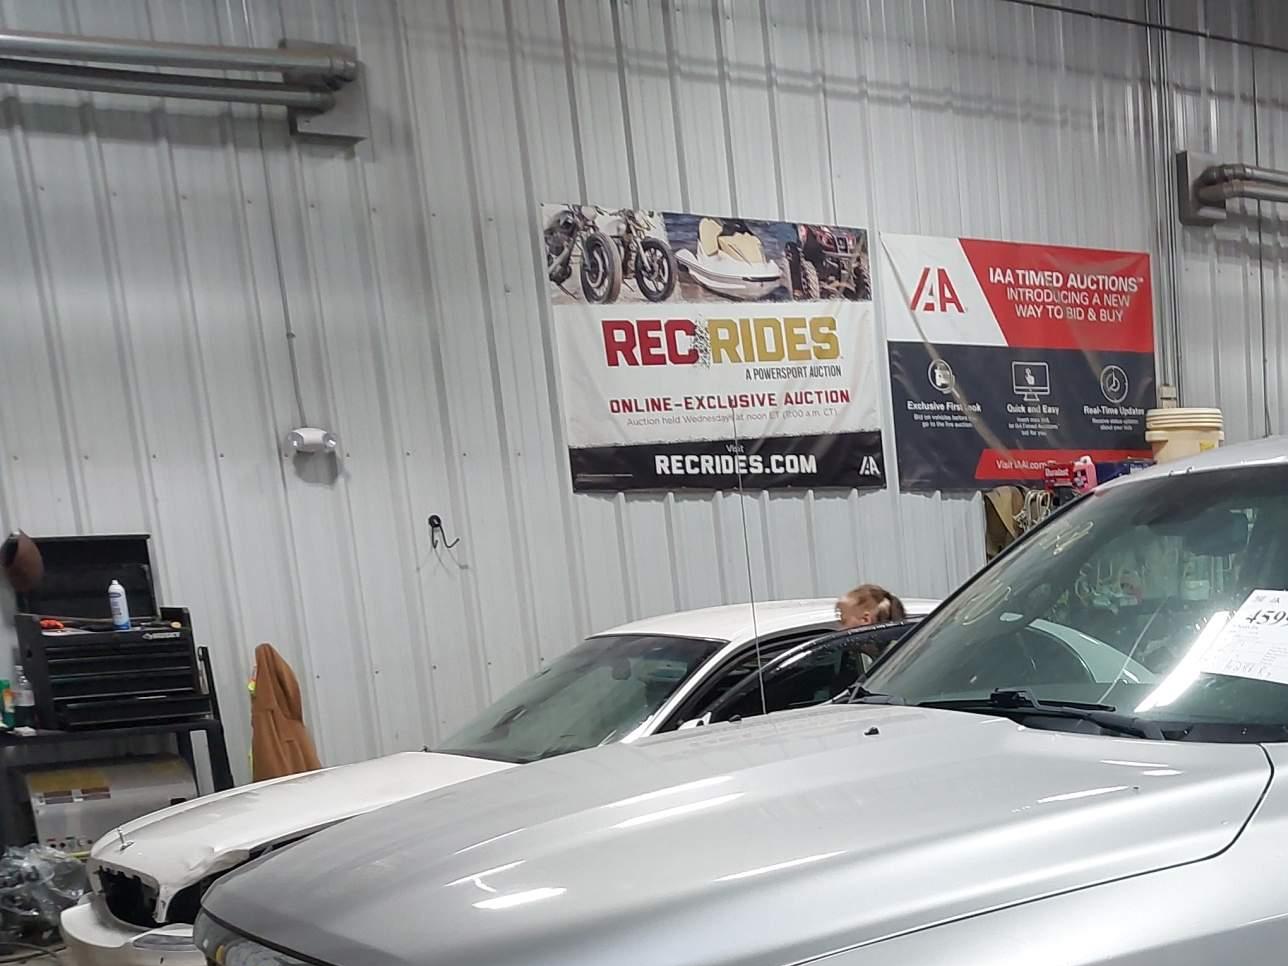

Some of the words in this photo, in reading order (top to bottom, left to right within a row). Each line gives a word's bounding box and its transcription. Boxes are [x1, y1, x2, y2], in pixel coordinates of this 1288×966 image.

[989, 267, 1014, 284] IAA
[1016, 270, 1063, 287] TIMED
[1067, 274, 1139, 292] AUCTIONS
[1007, 287, 1089, 305] INTRODUCING
[1092, 293, 1100, 305] A
[1104, 295, 1130, 307] NEW
[1015, 304, 1043, 318] WAY
[1046, 305, 1063, 319] TO
[1066, 307, 1084, 320] BID
[1088, 308, 1097, 321] &
[1100, 309, 1123, 322] BUY
[601, 319, 699, 367] REC
[707, 316, 840, 365] RIDES
[745, 369, 752, 380] A
[754, 366, 807, 380] POWERSPORT
[810, 365, 841, 378] AUCTION
[610, 393, 777, 413] ONLINE-EXCLUSIVE
[784, 390, 850, 405] AUCTION
[907, 401, 945, 411] Exclusive
[1007, 404, 1026, 413] Quick
[1027, 404, 1041, 413] and
[1042, 404, 1059, 416] Easy
[1083, 405, 1118, 415] Real-Time
[627, 416, 660, 426] Auction
[663, 416, 680, 425] held
[655, 455, 817, 475] RECRIDES.COM
[996, 460, 1012, 470] Visit
